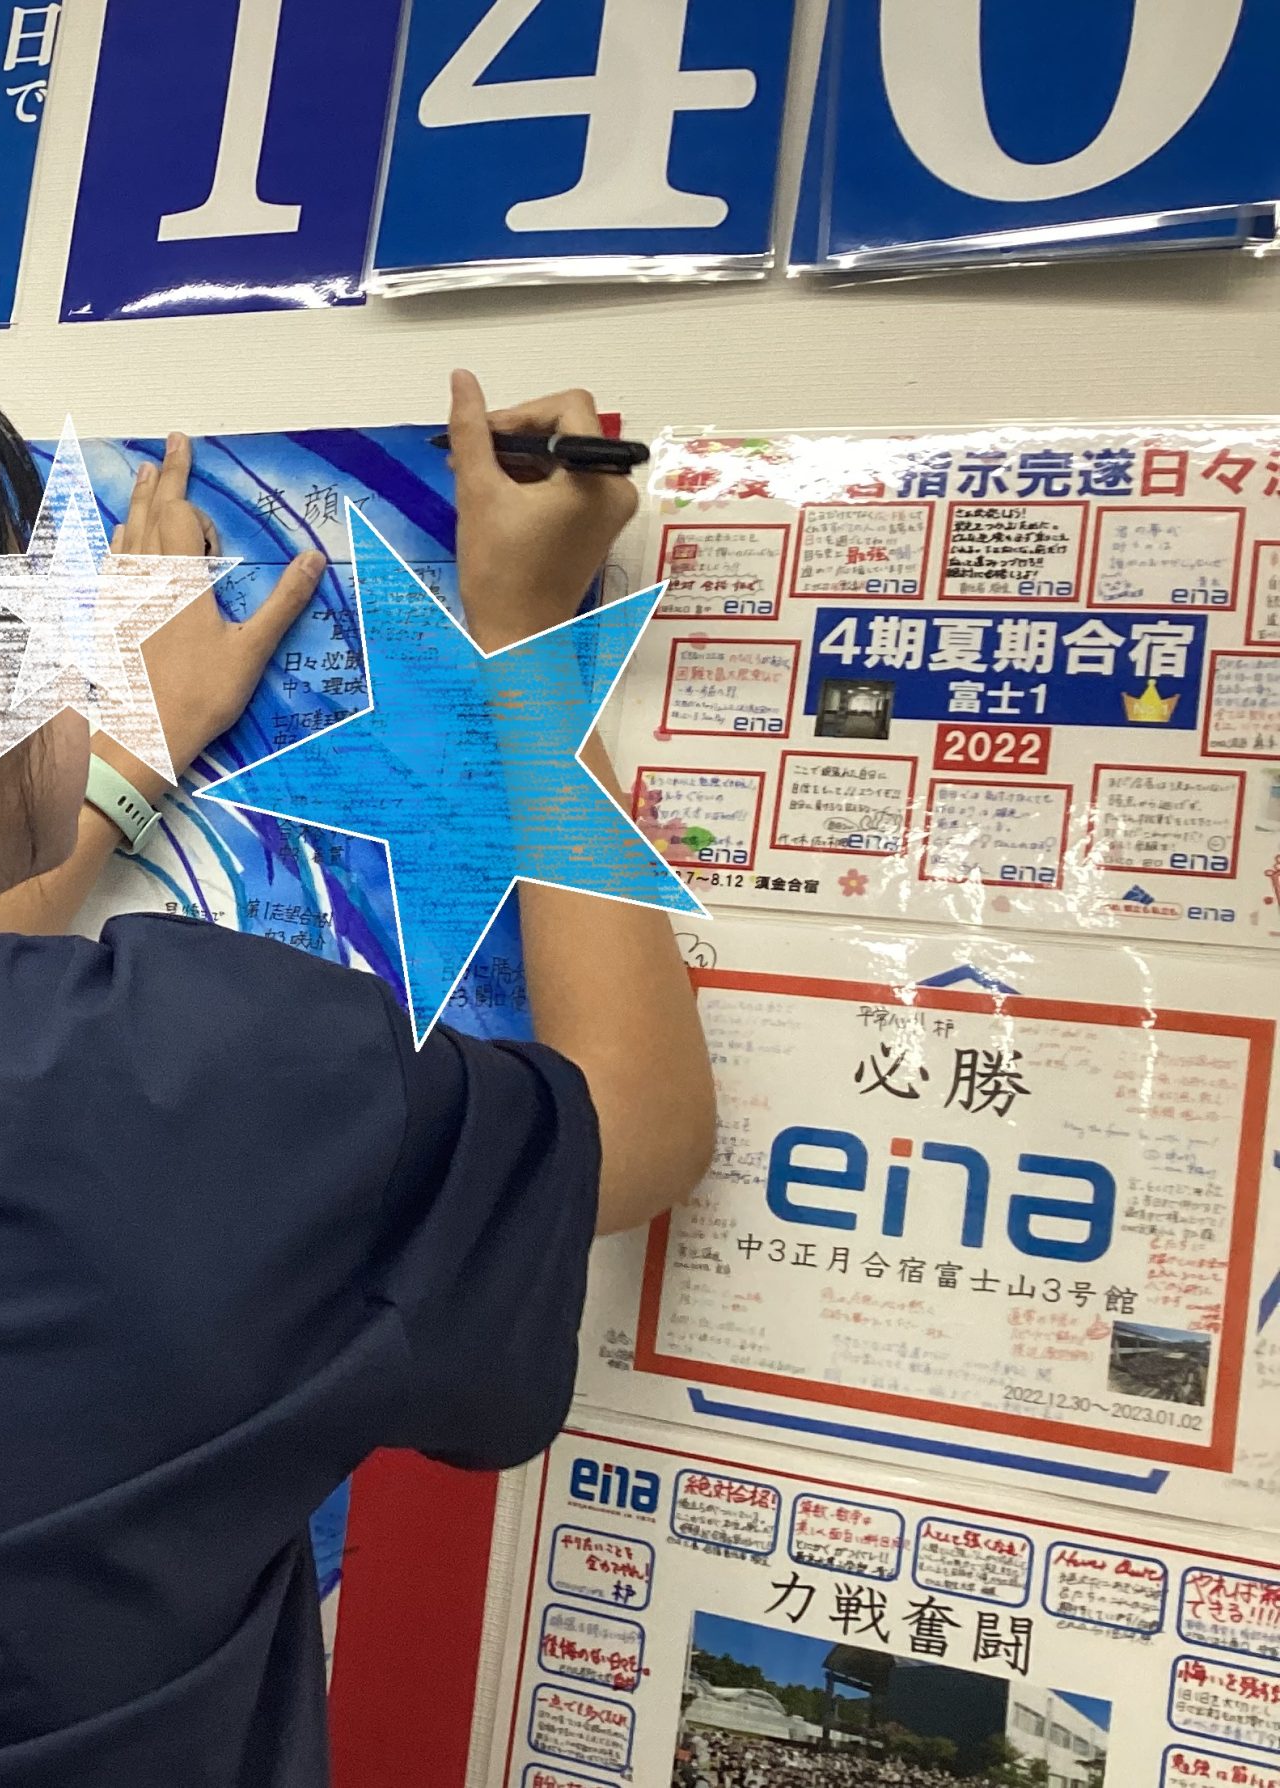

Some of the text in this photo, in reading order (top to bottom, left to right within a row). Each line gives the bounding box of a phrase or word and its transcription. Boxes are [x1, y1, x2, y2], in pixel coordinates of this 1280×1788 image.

[865, 579, 917, 594] ena
[1018, 580, 1072, 596] ena
[1171, 588, 1229, 604] ena
[723, 600, 773, 614] ena
[818, 613, 1195, 679] 4期夏期合宿
[948, 680, 1048, 714] 富士1
[734, 717, 783, 732] ena
[943, 731, 1042, 764] 2022
[849, 834, 900, 850] ena
[698, 847, 748, 864] ena
[1170, 852, 1228, 871] ena
[1001, 864, 1055, 882] ena
[1187, 905, 1236, 923] ena
[853, 1041, 1032, 1118] 必勝
[766, 1125, 1116, 1264] ena
[736, 1232, 1138, 1315] 中3正月合宿富士山3号館
[570, 1458, 661, 1514] ena
[765, 1571, 1034, 1677] 力戦奮闘
